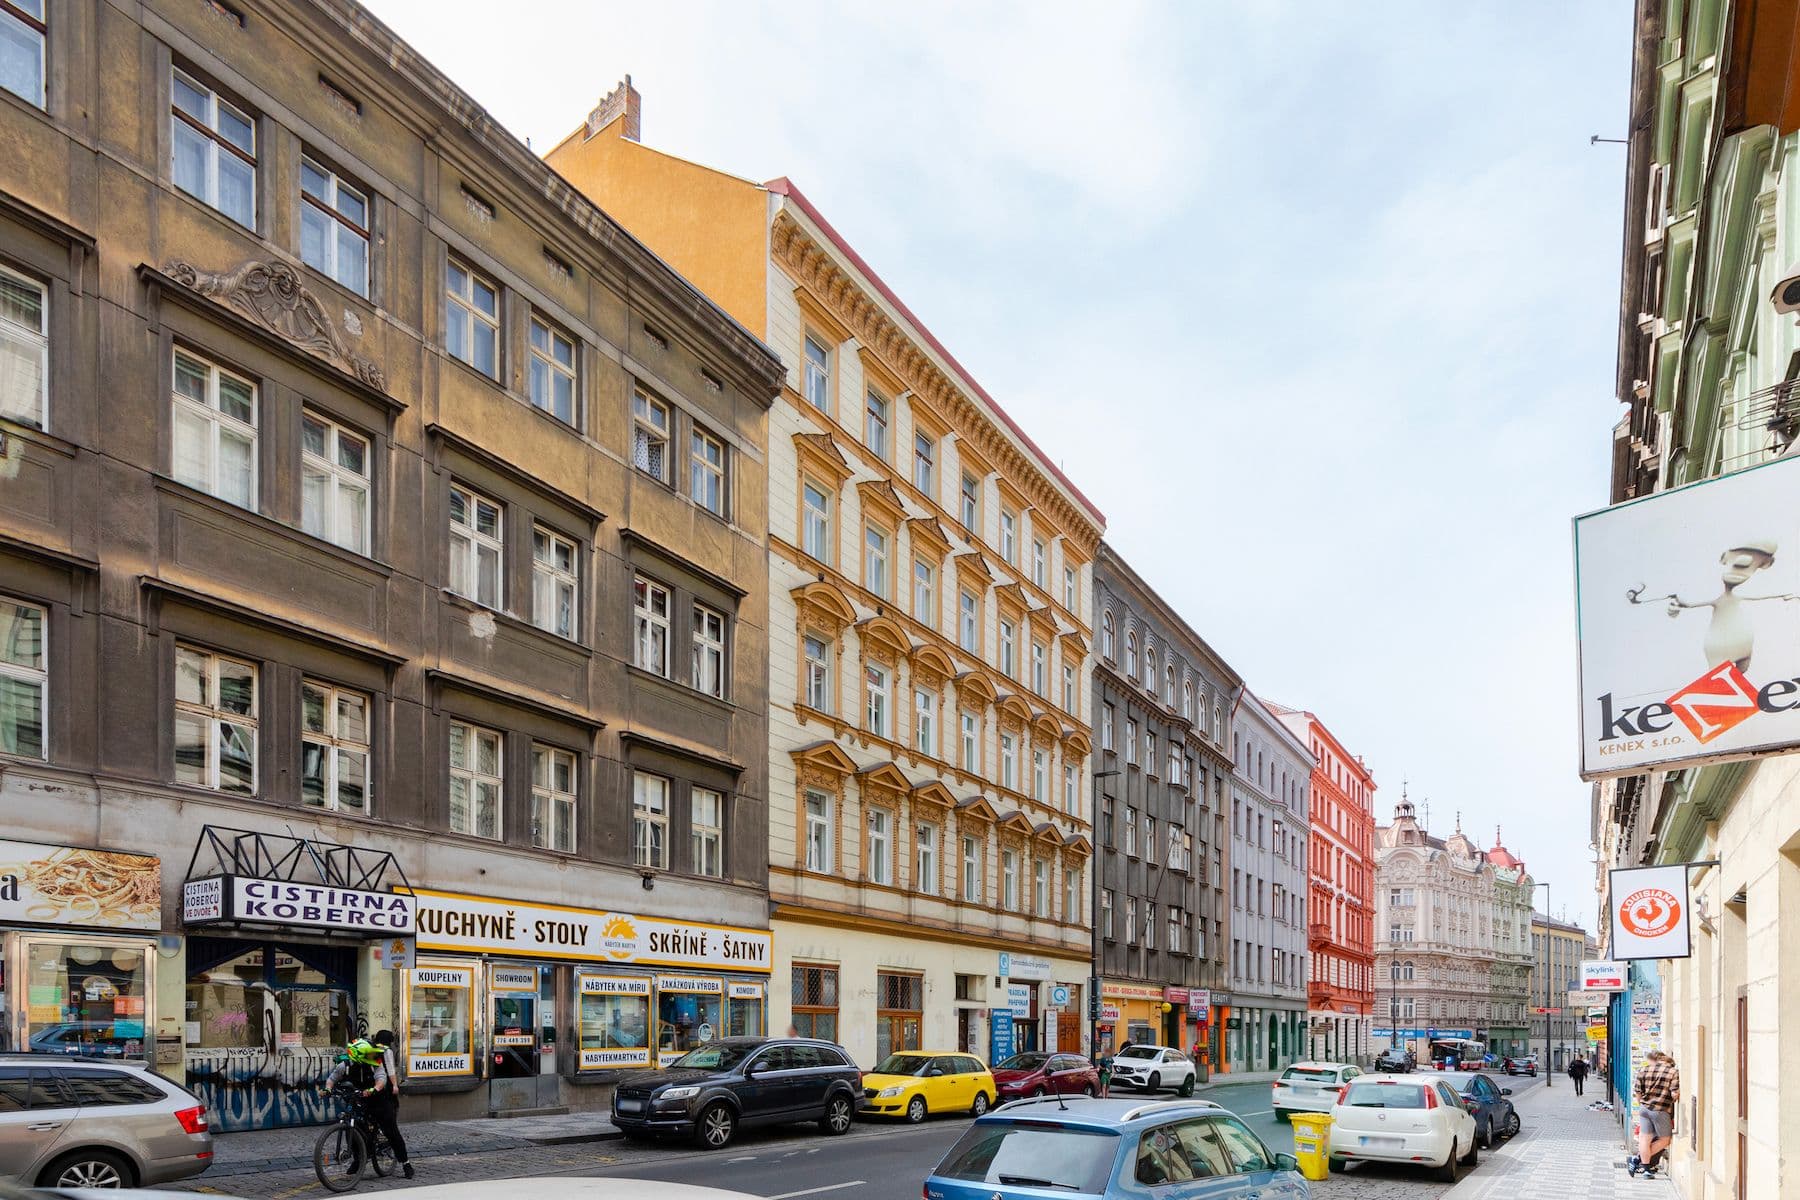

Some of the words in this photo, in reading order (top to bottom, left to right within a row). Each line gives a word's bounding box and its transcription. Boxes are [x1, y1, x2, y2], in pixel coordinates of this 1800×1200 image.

[1597, 666, 1800, 741] keNe
[1600, 741, 1645, 756] KENEX
[1652, 735, 1685, 747] s.r.o.
[245, 881, 408, 913] ČISTÍRNA
[1622, 889, 1677, 912] LOUISIANA
[416, 908, 515, 940] KUCHYNĚ
[535, 920, 588, 946] STOLY
[650, 928, 707, 956] SKŘÍNĚ
[723, 934, 765, 961] ŠATNY
[1586, 966, 1615, 974] skylink
[418, 972, 462, 983] KOUPELNY
[495, 974, 532, 983] SHOWROOM
[585, 980, 616, 991] NÁBYTEK
[617, 982, 627, 991] NA
[628, 981, 646, 993] MÍRU
[661, 978, 695, 990] ZAKÁZKOVÁ
[697, 978, 719, 991] VÝROBA
[736, 987, 756, 995] KOMODY
[415, 1057, 465, 1071] KANCELÁŘE
[585, 1052, 647, 1063] NABYTEKMARTYN.CZ
